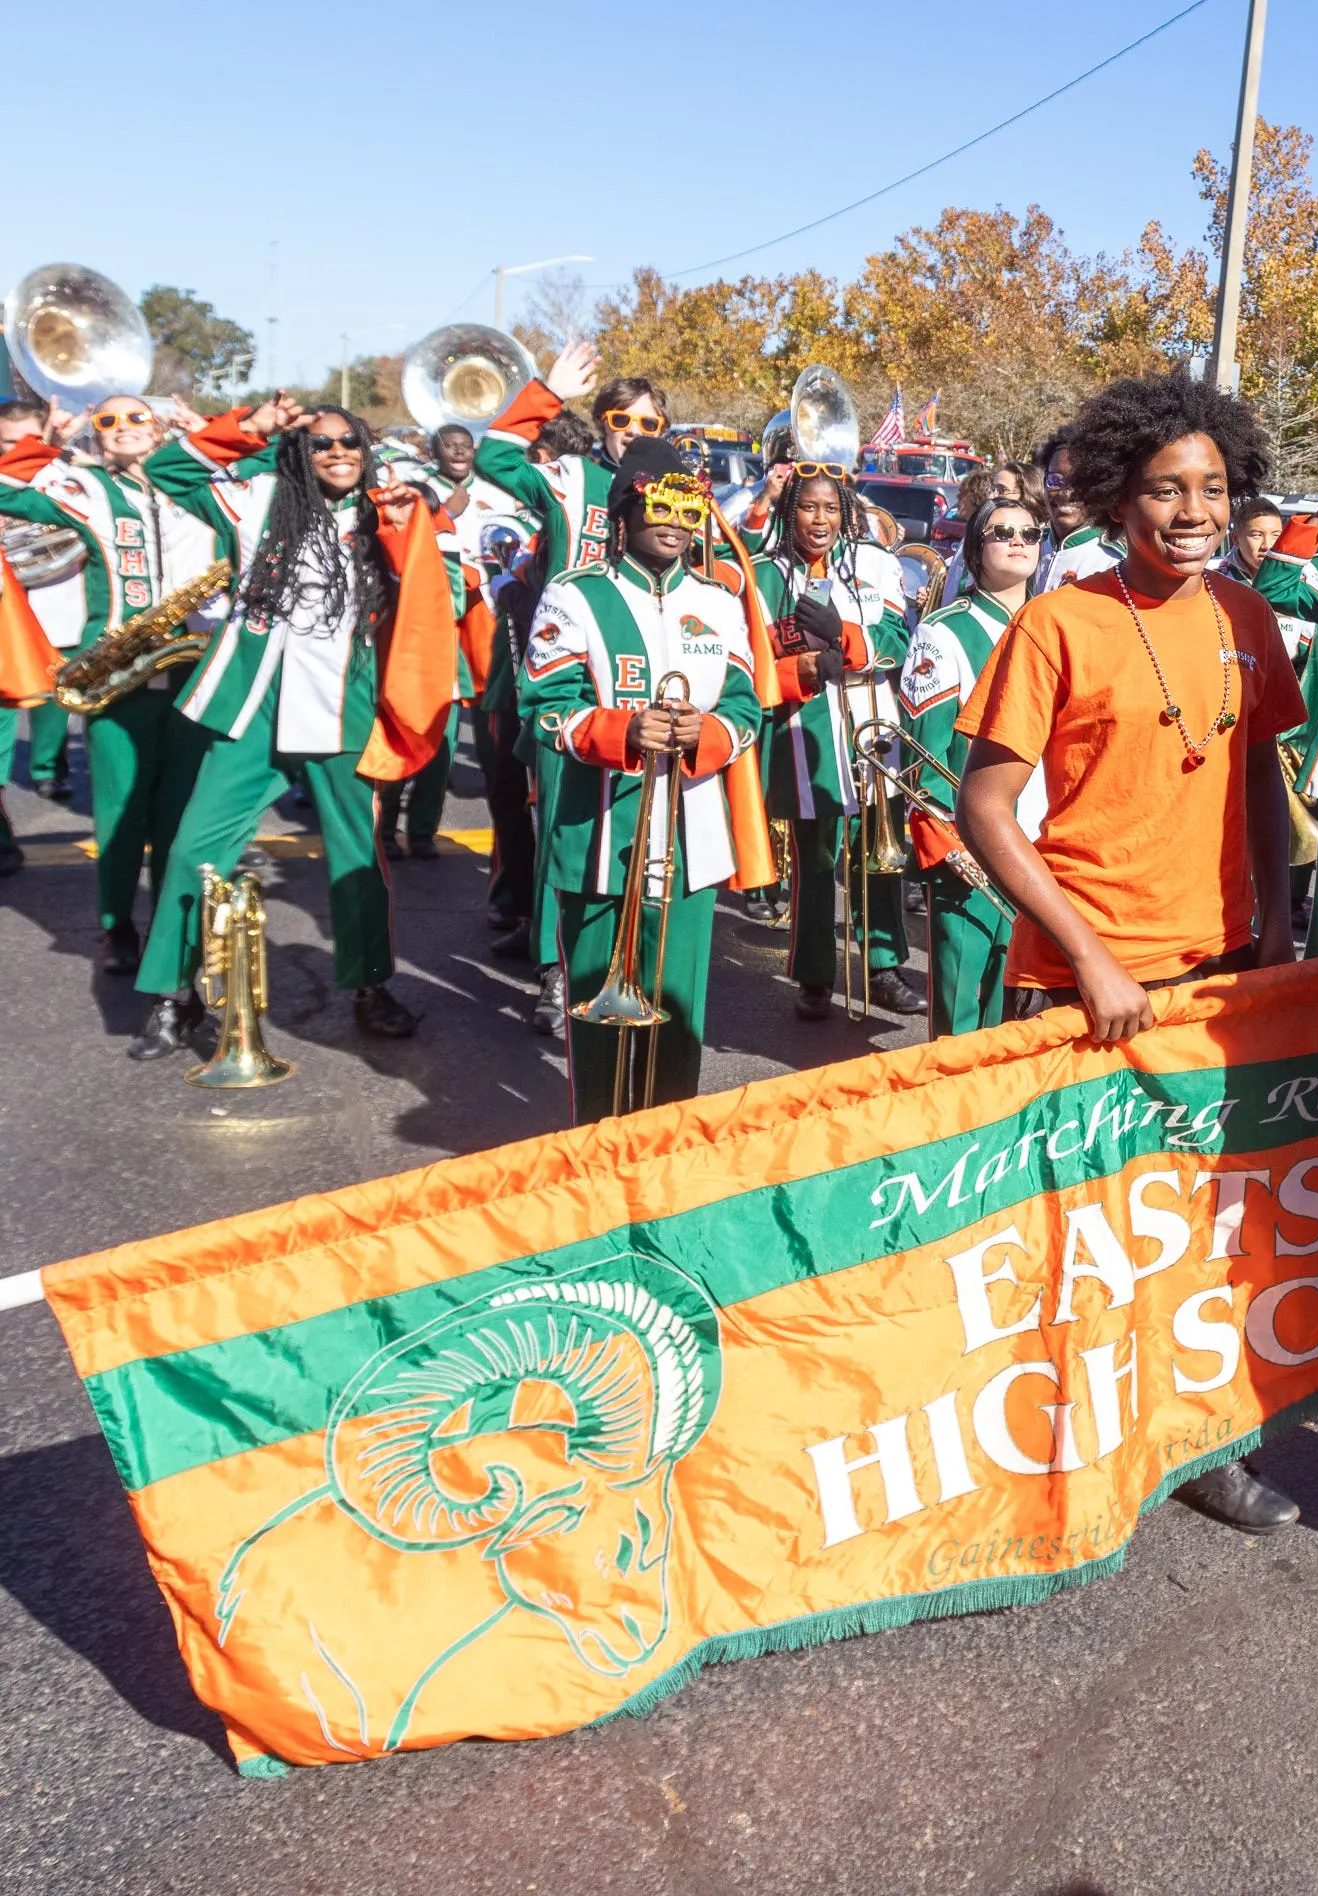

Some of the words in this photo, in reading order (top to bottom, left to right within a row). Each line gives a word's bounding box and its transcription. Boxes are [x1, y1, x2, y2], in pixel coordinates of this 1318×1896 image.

[115, 517, 151, 608] EHS
[681, 643, 723, 656] RAMS
[1280, 623, 1294, 632] MS
[870, 1084, 1239, 1229] Marching
